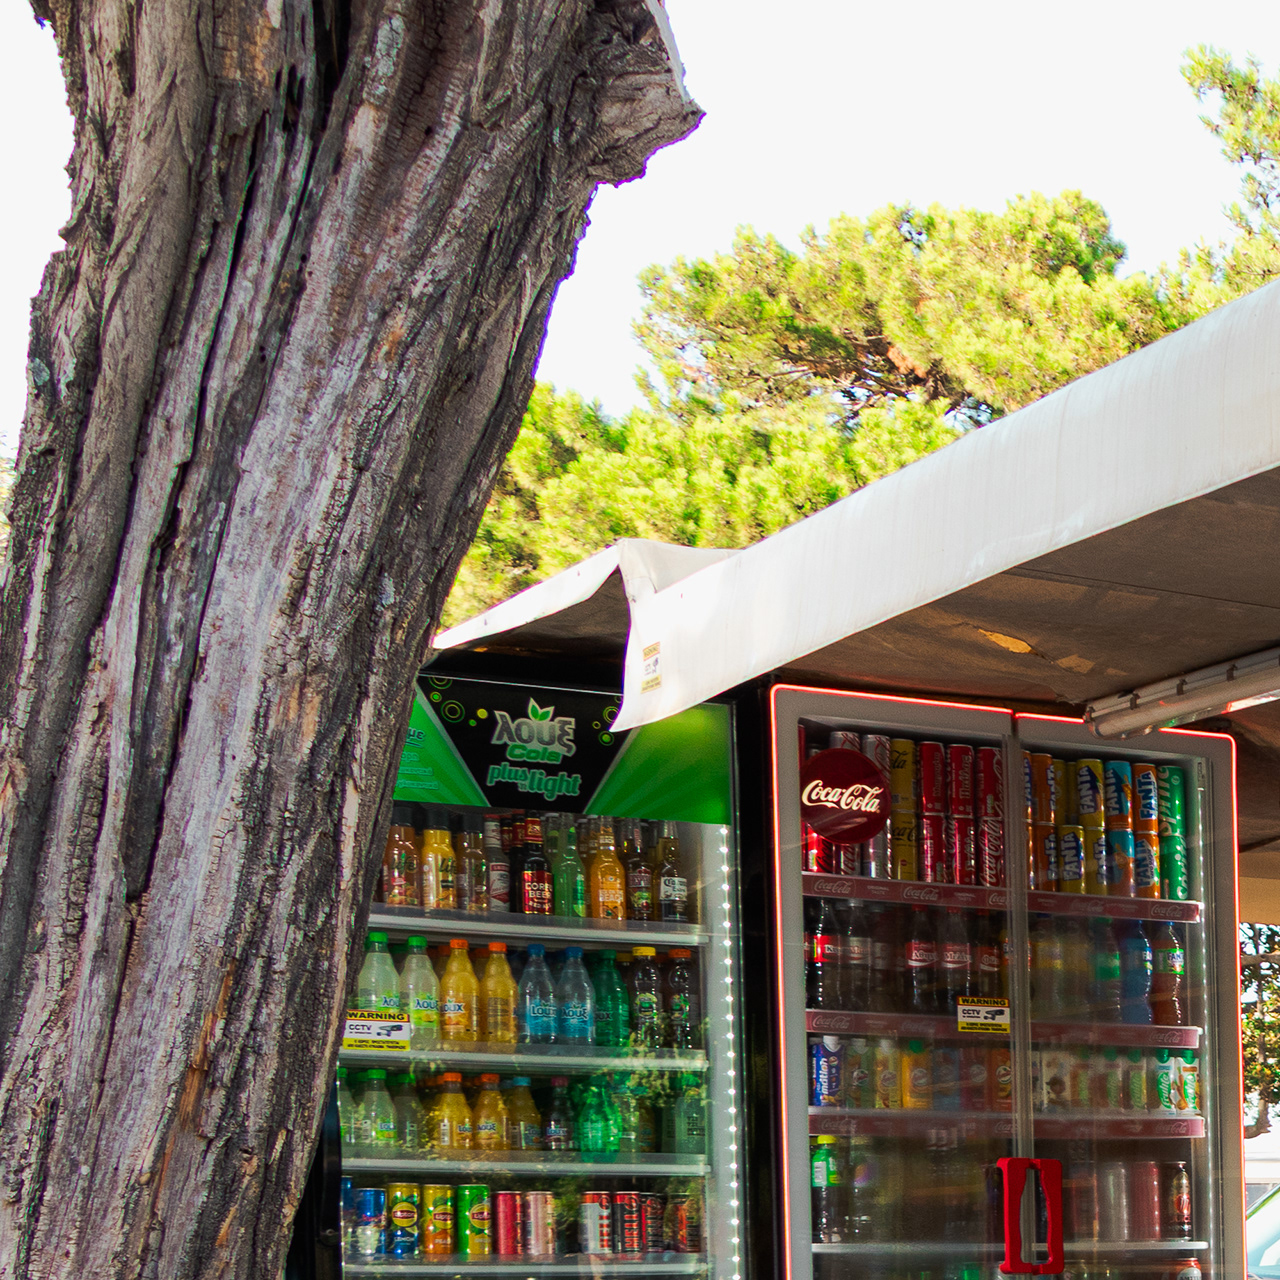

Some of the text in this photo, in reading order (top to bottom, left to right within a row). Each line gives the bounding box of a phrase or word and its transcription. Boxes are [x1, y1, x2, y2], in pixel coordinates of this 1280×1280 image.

[491, 710, 577, 757] λουξ
[506, 743, 564, 764] Cola
[487, 762, 582, 801] plus light
[801, 778, 885, 815] Coca-Cola
[1077, 765, 1099, 815] FANTA
[1137, 771, 1158, 821] FANTA
[1060, 831, 1081, 881] FANTA
[347, 1012, 406, 1020] WARNING
[961, 997, 1006, 1006] WARNING
[962, 1008, 981, 1016] CCTV
